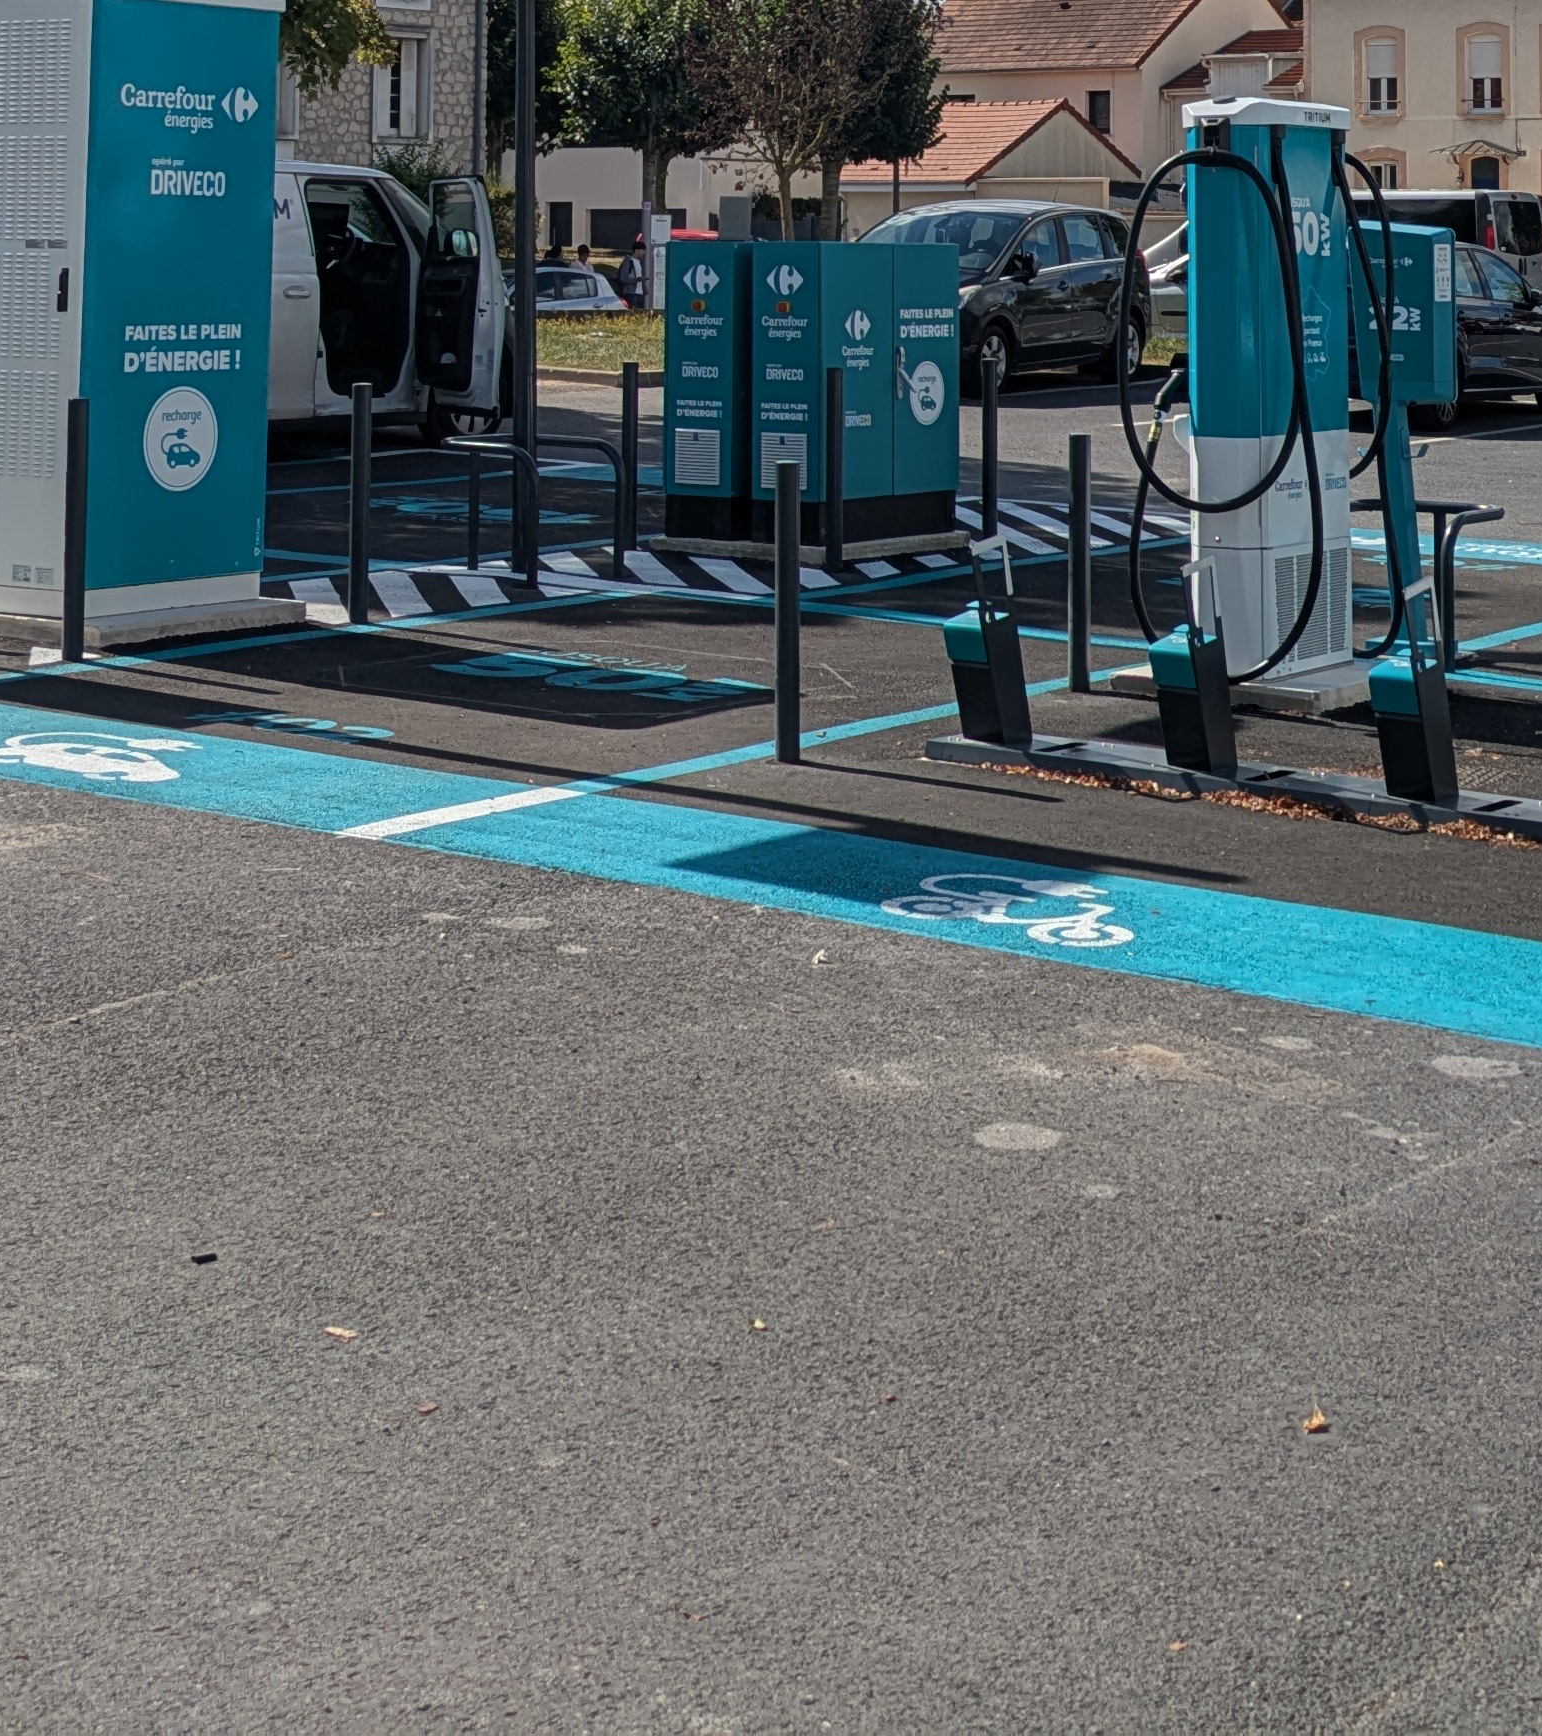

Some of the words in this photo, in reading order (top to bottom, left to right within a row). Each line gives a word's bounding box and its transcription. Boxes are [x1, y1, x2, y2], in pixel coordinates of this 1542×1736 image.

[120, 83, 216, 111] Carrefour
[164, 109, 214, 134] énergies
[150, 168, 226, 197] DRIVECO
[1320, 212, 1331, 257] kW
[678, 314, 724, 325] Carrefour
[761, 315, 808, 327] Carrefour
[1409, 306, 1421, 332] kW
[124, 325, 178, 342] FAITES
[180, 324, 198, 340] LE
[200, 323, 242, 340] PLEIN
[900, 321, 950, 339] D'ÉNERGIE
[123, 345, 231, 373] D'ÉNERGIE
[234, 349, 241, 370] !
[682, 365, 719, 378] DRIVECO
[766, 368, 804, 381] DRIVECO
[161, 409, 202, 425] recharge
